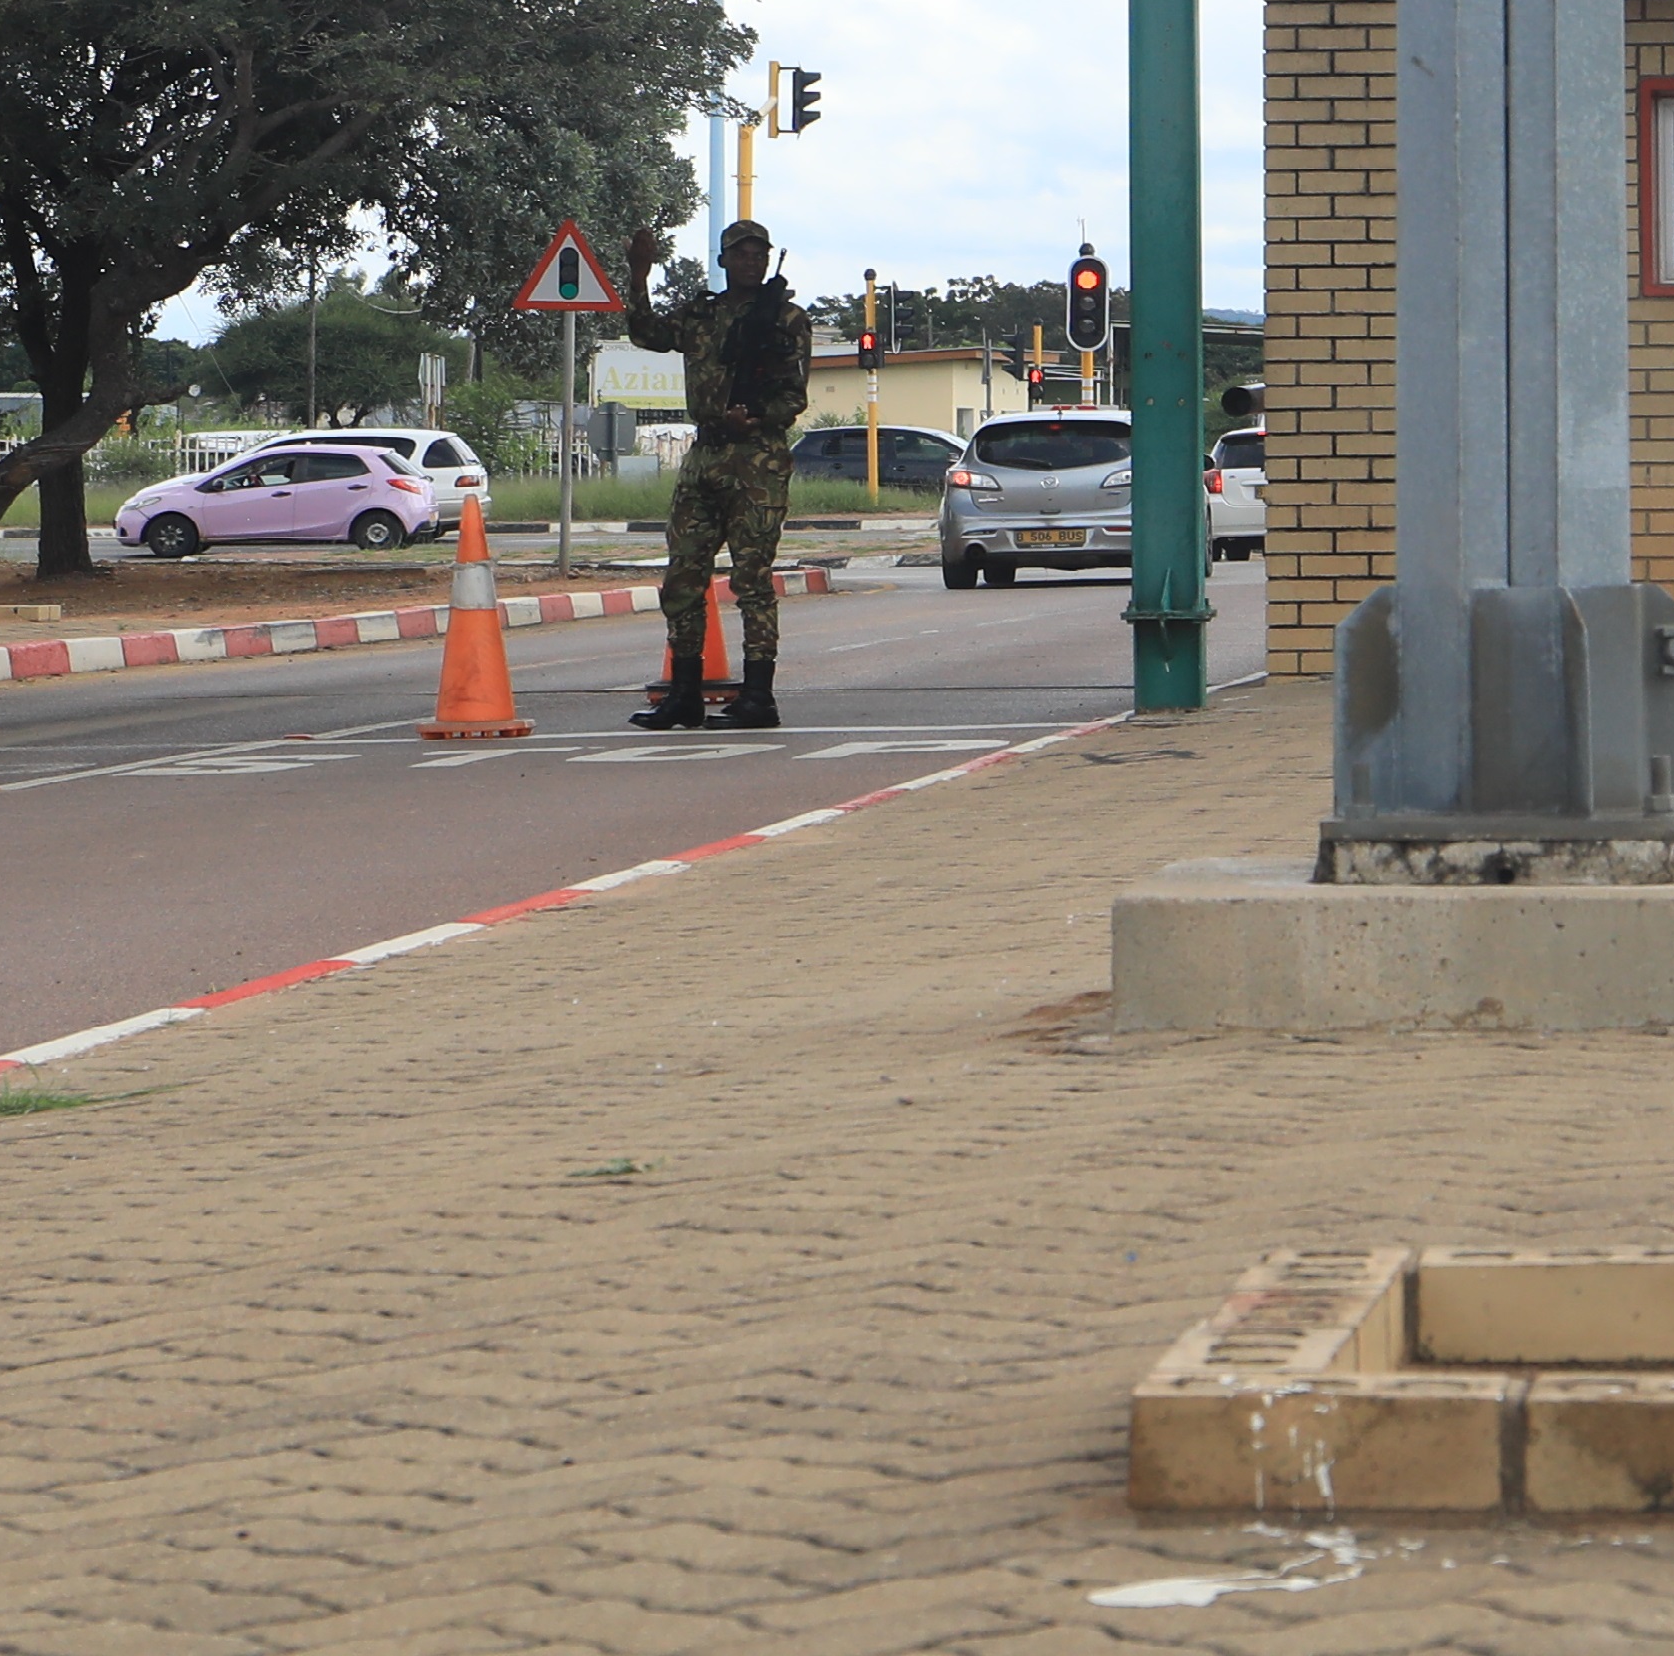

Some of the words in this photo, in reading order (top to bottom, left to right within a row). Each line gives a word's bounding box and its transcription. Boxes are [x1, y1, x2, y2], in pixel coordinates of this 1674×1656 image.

[1016, 532, 1024, 542] B
[1030, 531, 1052, 542] 506
[1059, 530, 1083, 541] BUS
[113, 738, 1010, 777] STOP
